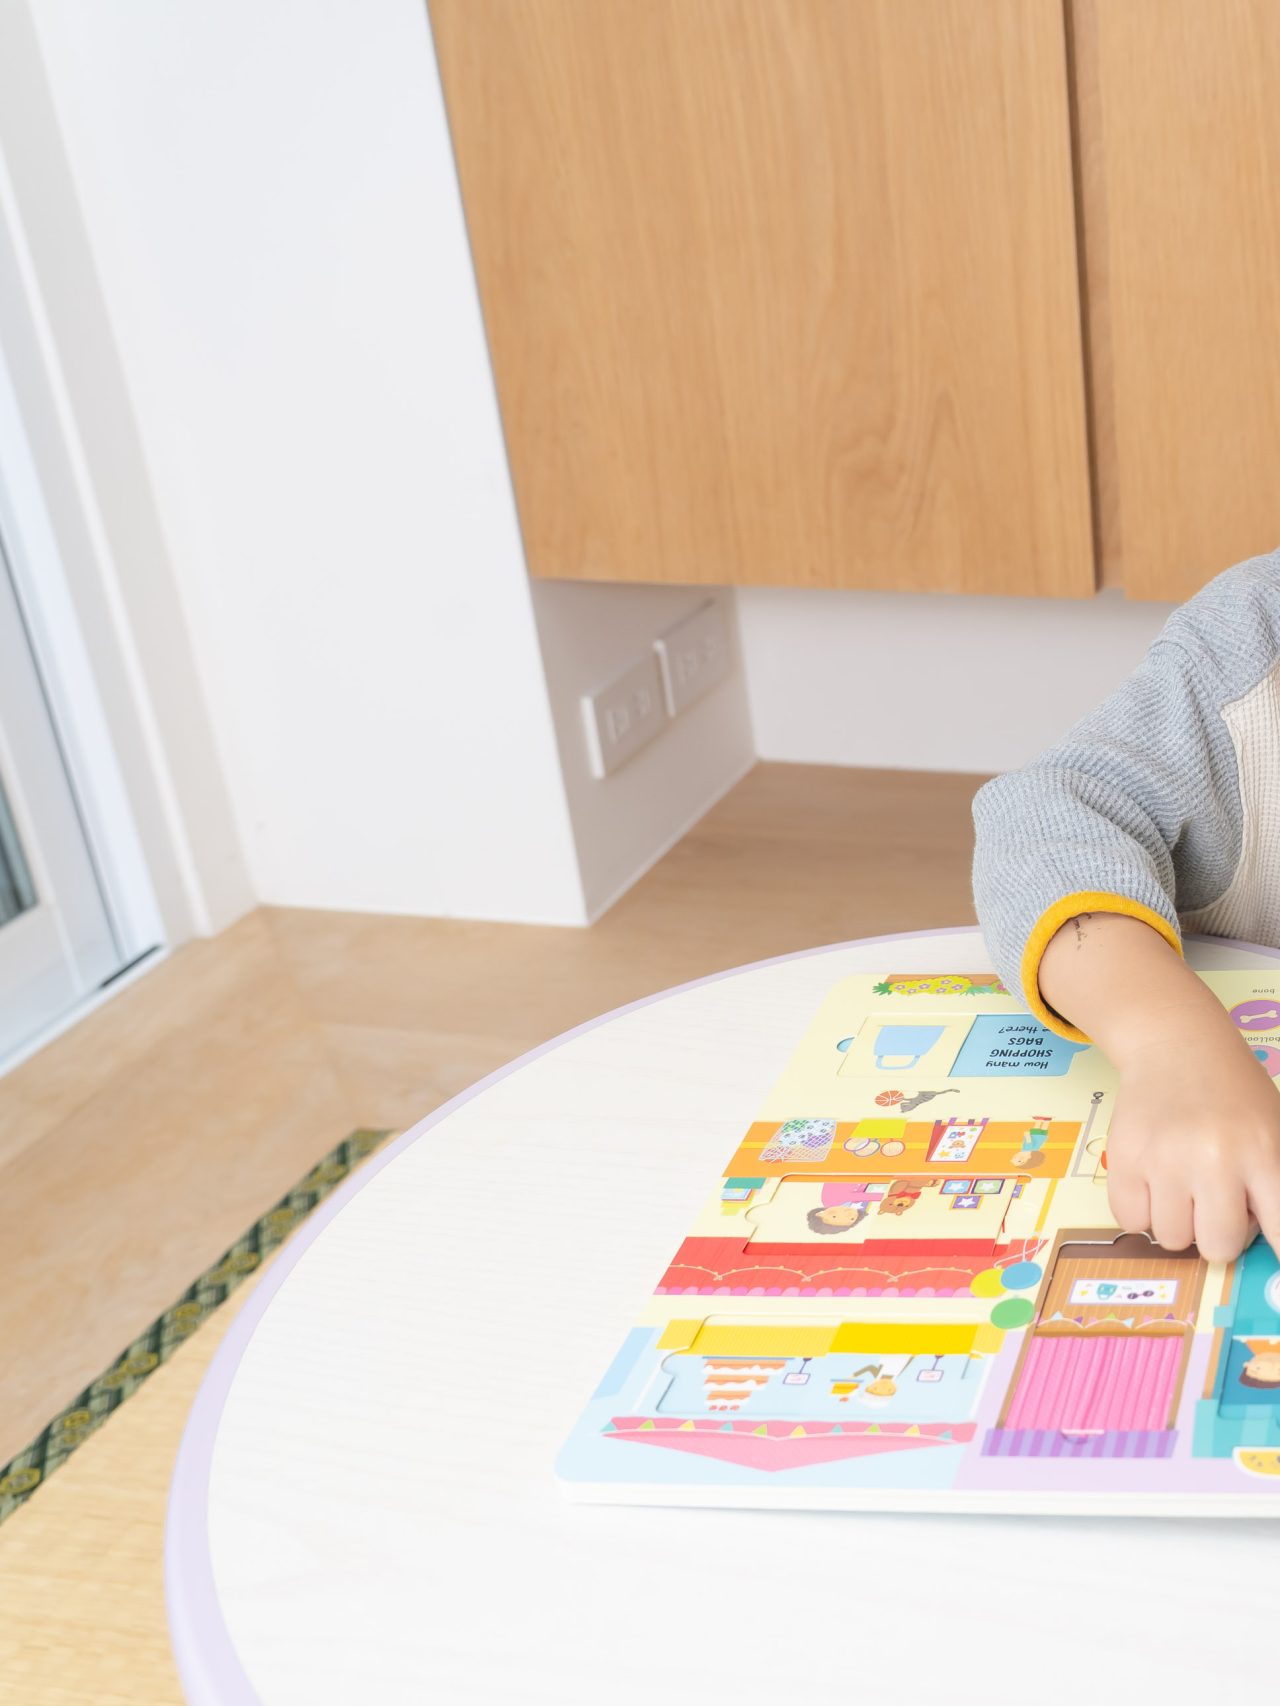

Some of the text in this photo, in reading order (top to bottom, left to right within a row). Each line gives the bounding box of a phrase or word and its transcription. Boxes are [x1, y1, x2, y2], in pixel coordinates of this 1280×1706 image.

[1252, 987, 1275, 995] bone
[998, 1026, 1038, 1034] there?
[1008, 1037, 1044, 1046] BAGS
[989, 1048, 1053, 1058] SHOPPING
[985, 1060, 1049, 1069] How many
